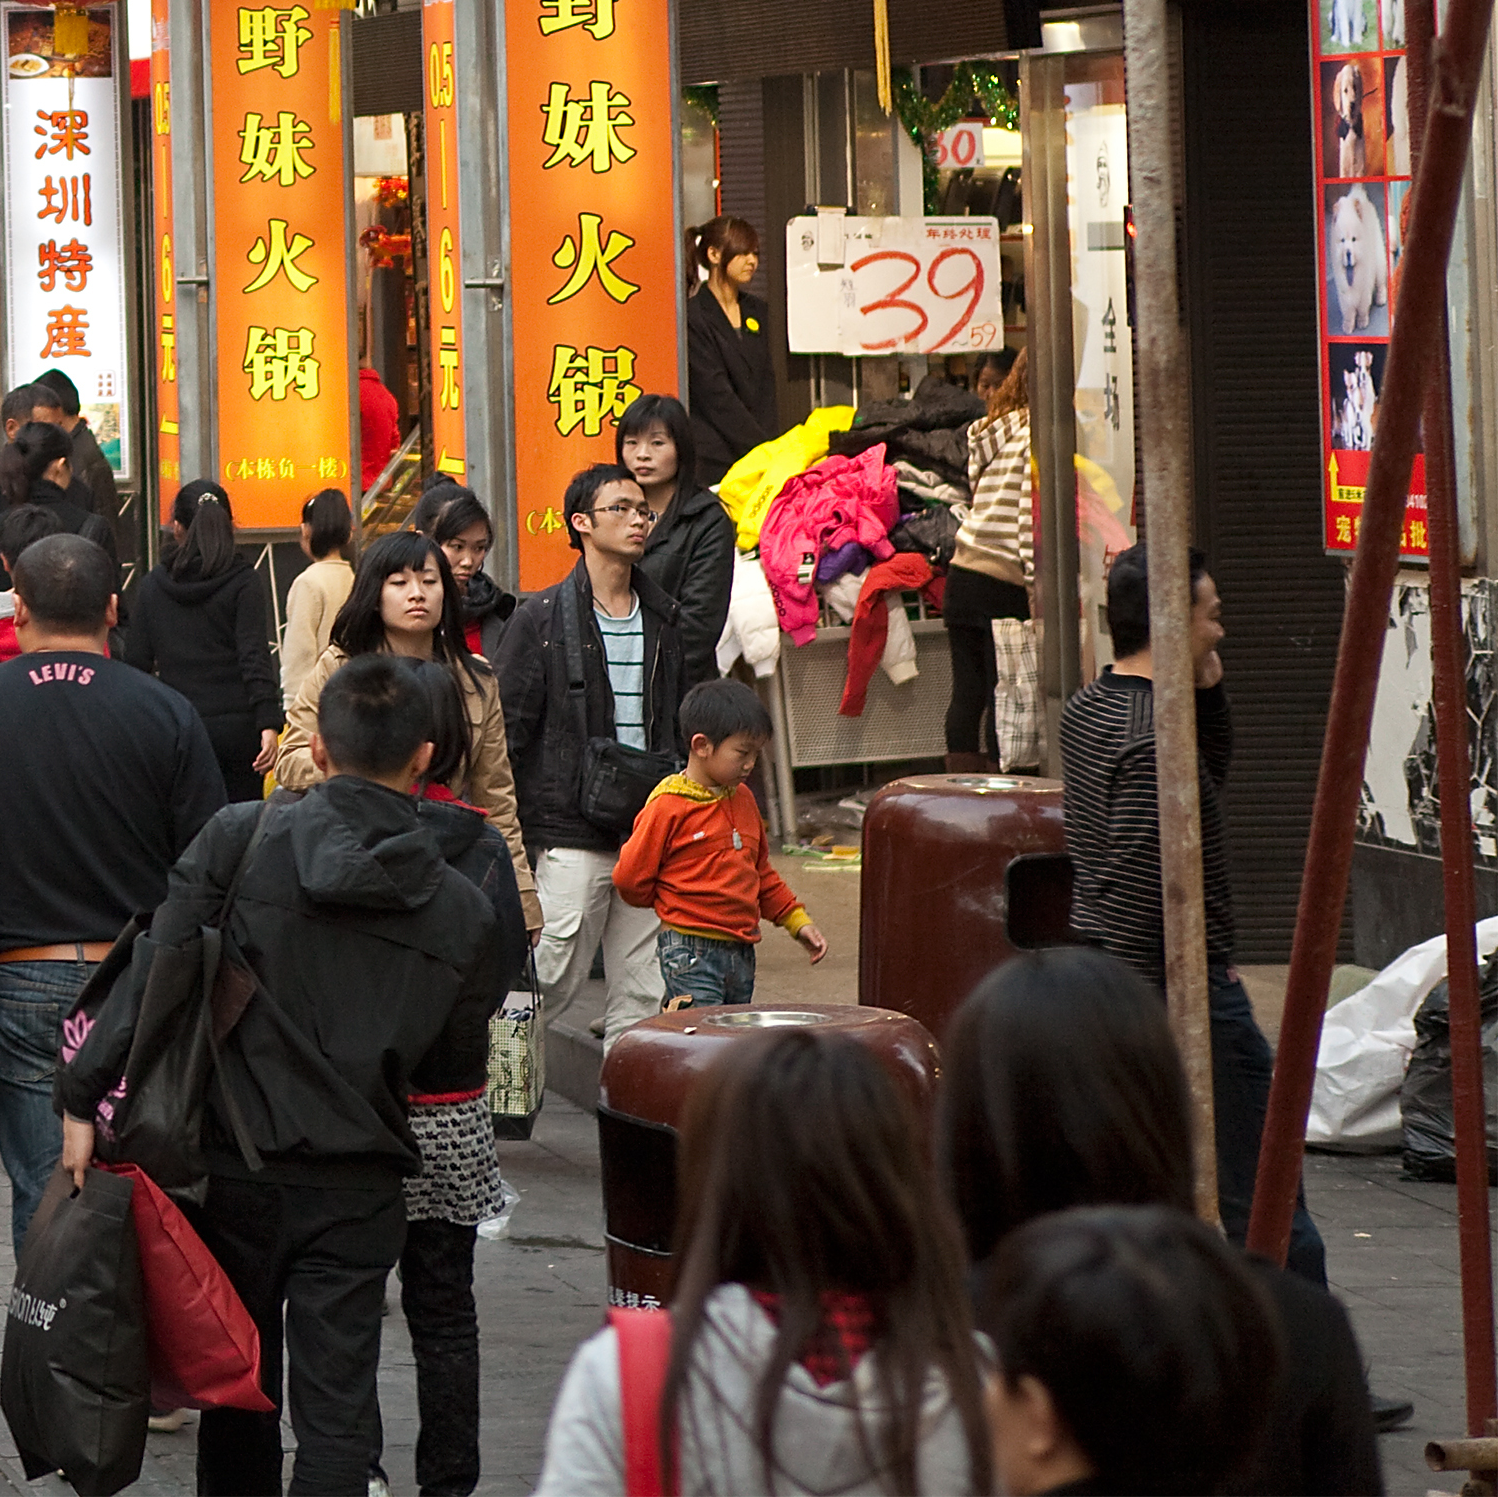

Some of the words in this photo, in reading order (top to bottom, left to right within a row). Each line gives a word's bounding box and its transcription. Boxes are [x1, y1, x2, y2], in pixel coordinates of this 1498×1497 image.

[237, 5, 321, 401] 野妹火锅
[850, 247, 985, 353] 39
[224, 455, 348, 481] (本栋负一楼)
[28, 662, 96, 686] LEVI'S
